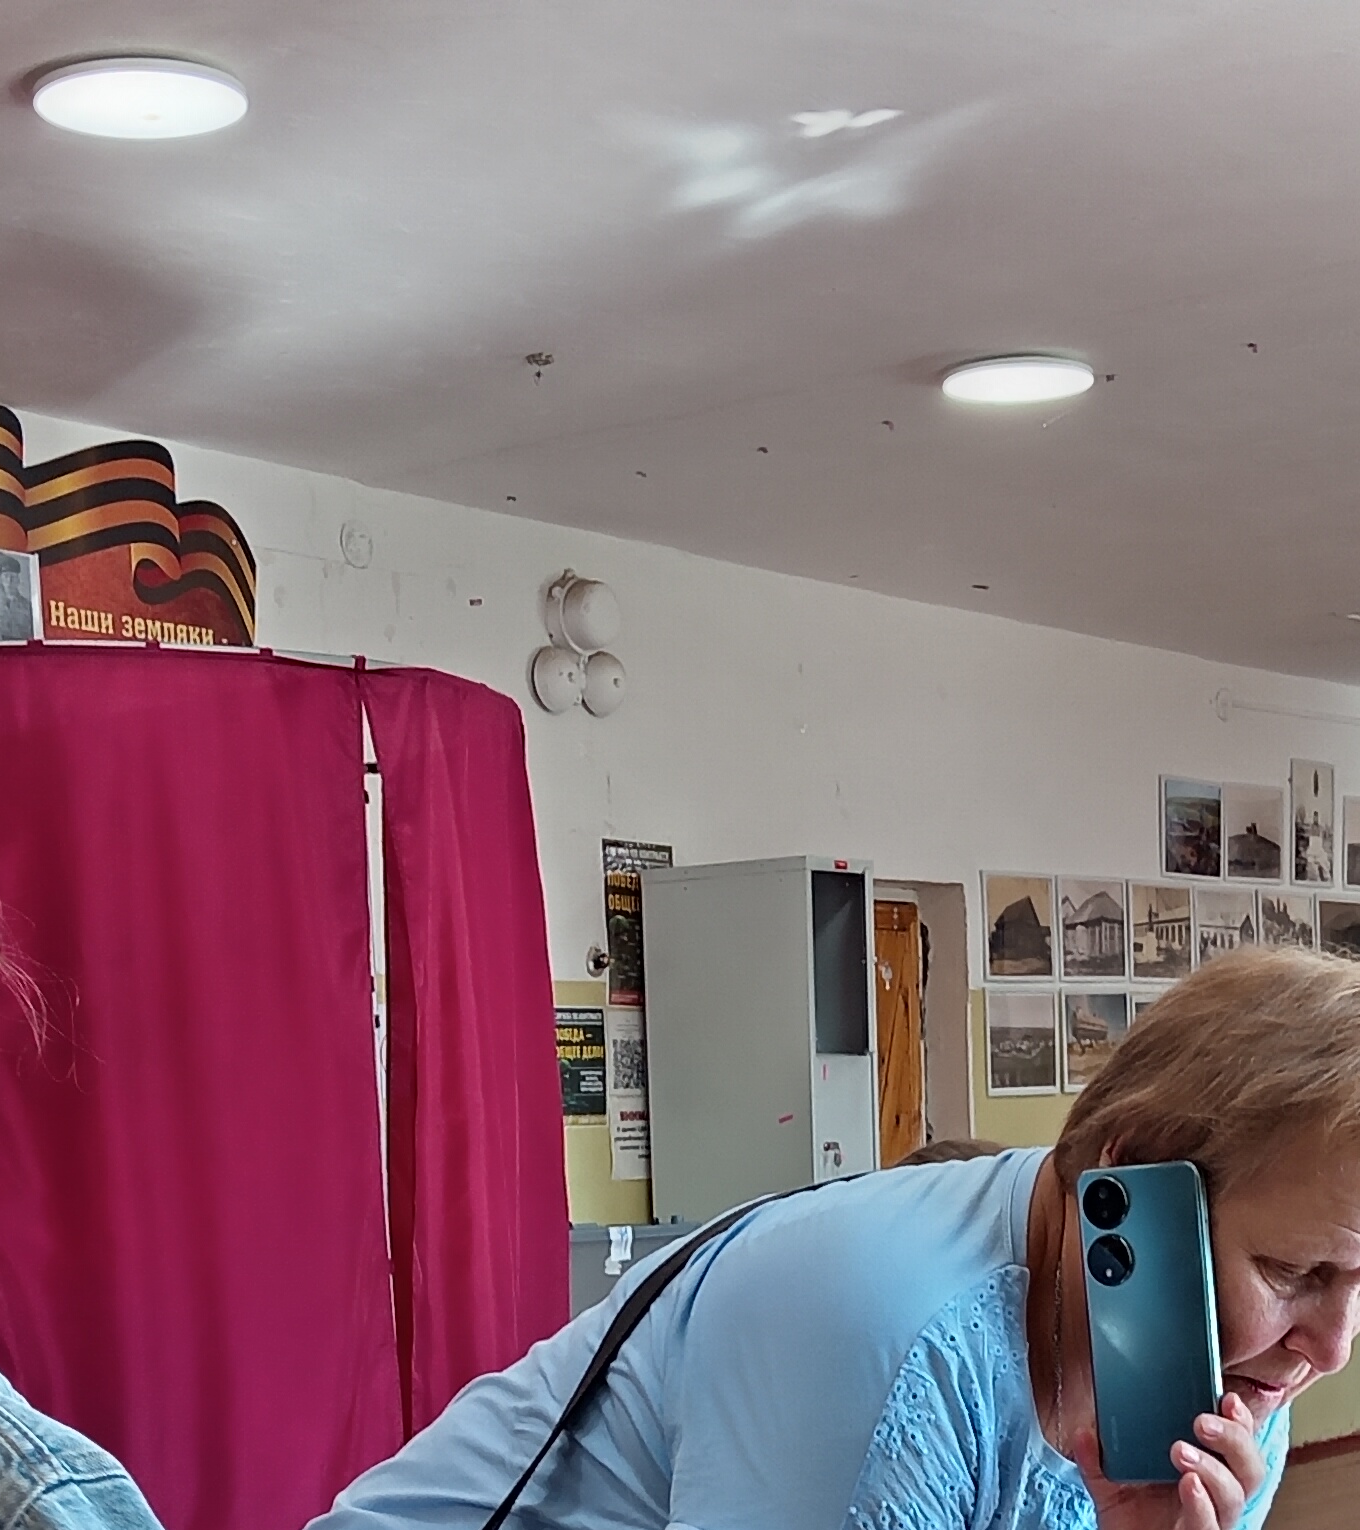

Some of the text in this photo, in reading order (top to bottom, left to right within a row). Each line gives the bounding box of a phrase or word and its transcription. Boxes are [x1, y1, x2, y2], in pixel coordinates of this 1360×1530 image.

[49, 600, 114, 635] Наши
[121, 615, 214, 646] земляки
[607, 869, 639, 891] ПОБЕД
